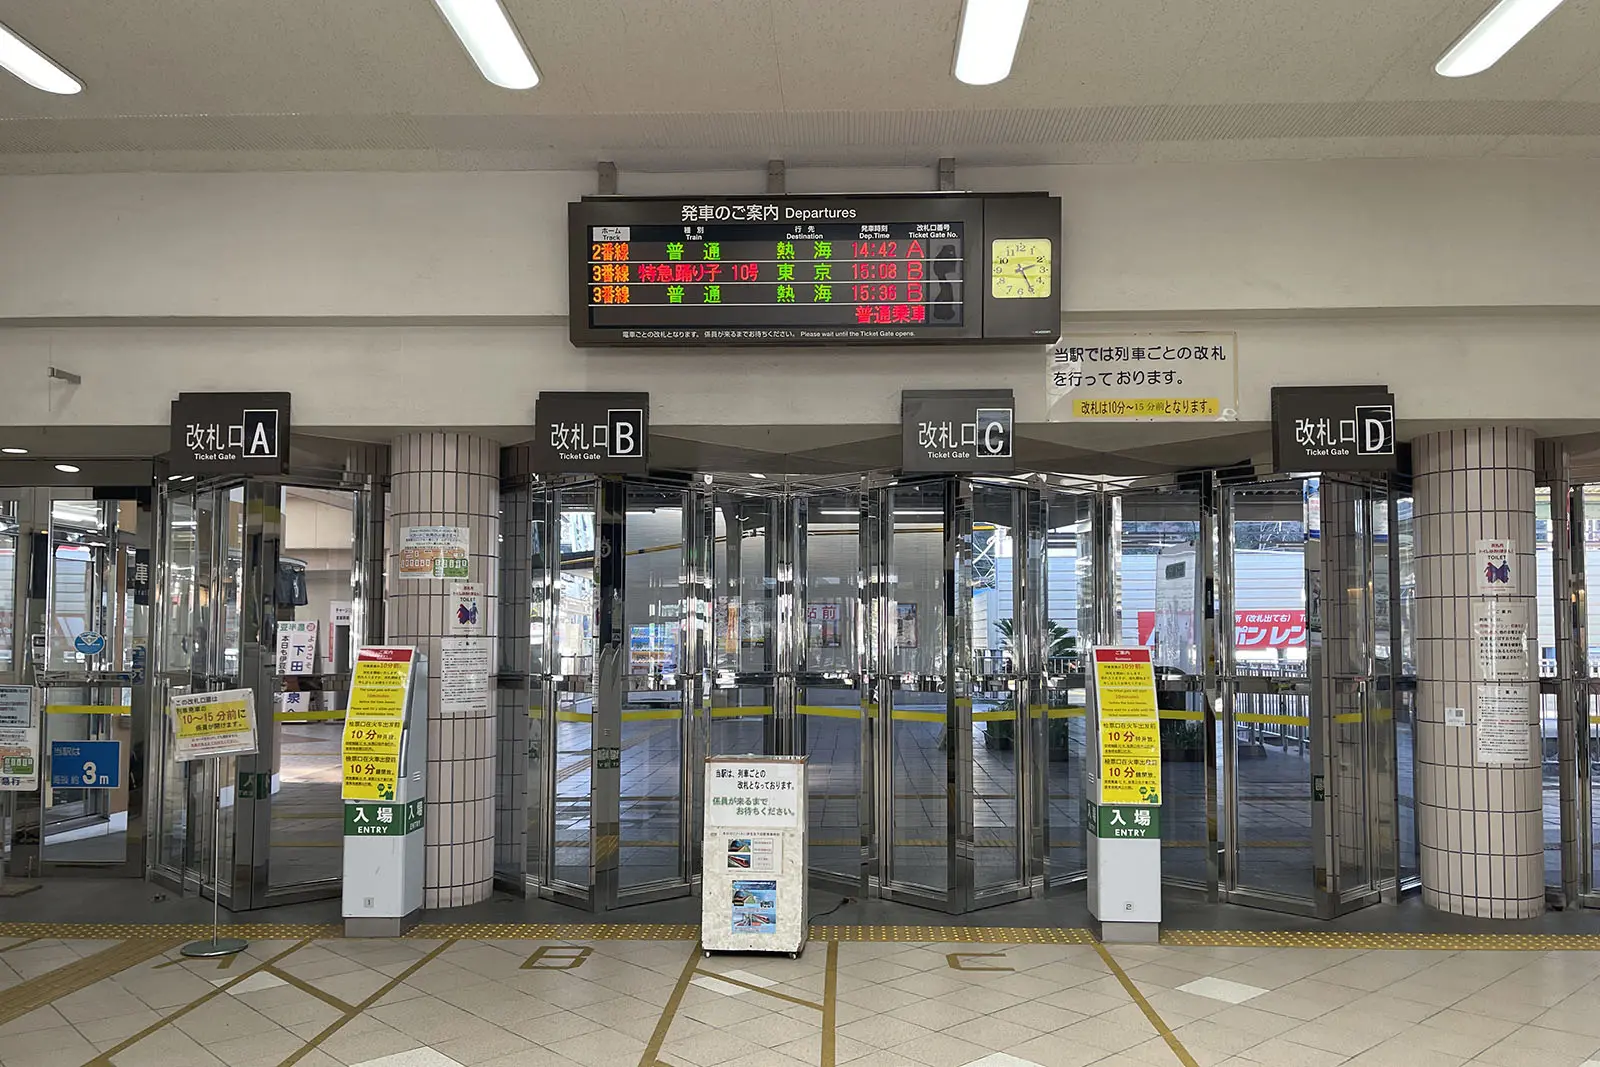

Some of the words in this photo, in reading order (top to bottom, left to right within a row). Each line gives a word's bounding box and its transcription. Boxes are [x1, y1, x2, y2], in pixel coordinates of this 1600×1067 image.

[681, 205, 779, 221] 発車のご案内
[785, 208, 857, 220] Departures
[592, 242, 629, 260] 2番線
[666, 242, 720, 260] 普通
[852, 242, 897, 258] 14:42
[906, 240, 924, 258] A
[592, 265, 629, 282] 3番線
[732, 263, 758, 282] 10号
[777, 263, 832, 281] 東京
[852, 262, 897, 280] 15:08
[907, 262, 924, 280] B
[592, 286, 630, 304] 3番線
[667, 286, 722, 304] 普通
[852, 284, 897, 301] 15:36
[907, 284, 924, 302] B
[1054, 346, 1226, 362] 当駅では列車ごとの改札
[1054, 370, 1184, 387] を行っております。
[186, 424, 243, 450] 改札口
[250, 422, 270, 454] A
[550, 422, 608, 450] 改札口
[616, 422, 634, 454] B
[918, 421, 976, 448] 改札口
[984, 421, 1004, 453] C
[1296, 418, 1356, 446] 改札口
[1365, 418, 1385, 452] D
[306, 636, 314, 669] ようこそ
[82, 761, 97, 785] 3
[100, 776, 109, 784] m
[738, 781, 794, 790] 改札となっております。
[354, 807, 393, 823] 入場
[736, 808, 795, 816] お待ちください。
[1110, 809, 1151, 826] 入場
[519, 946, 596, 970] B
